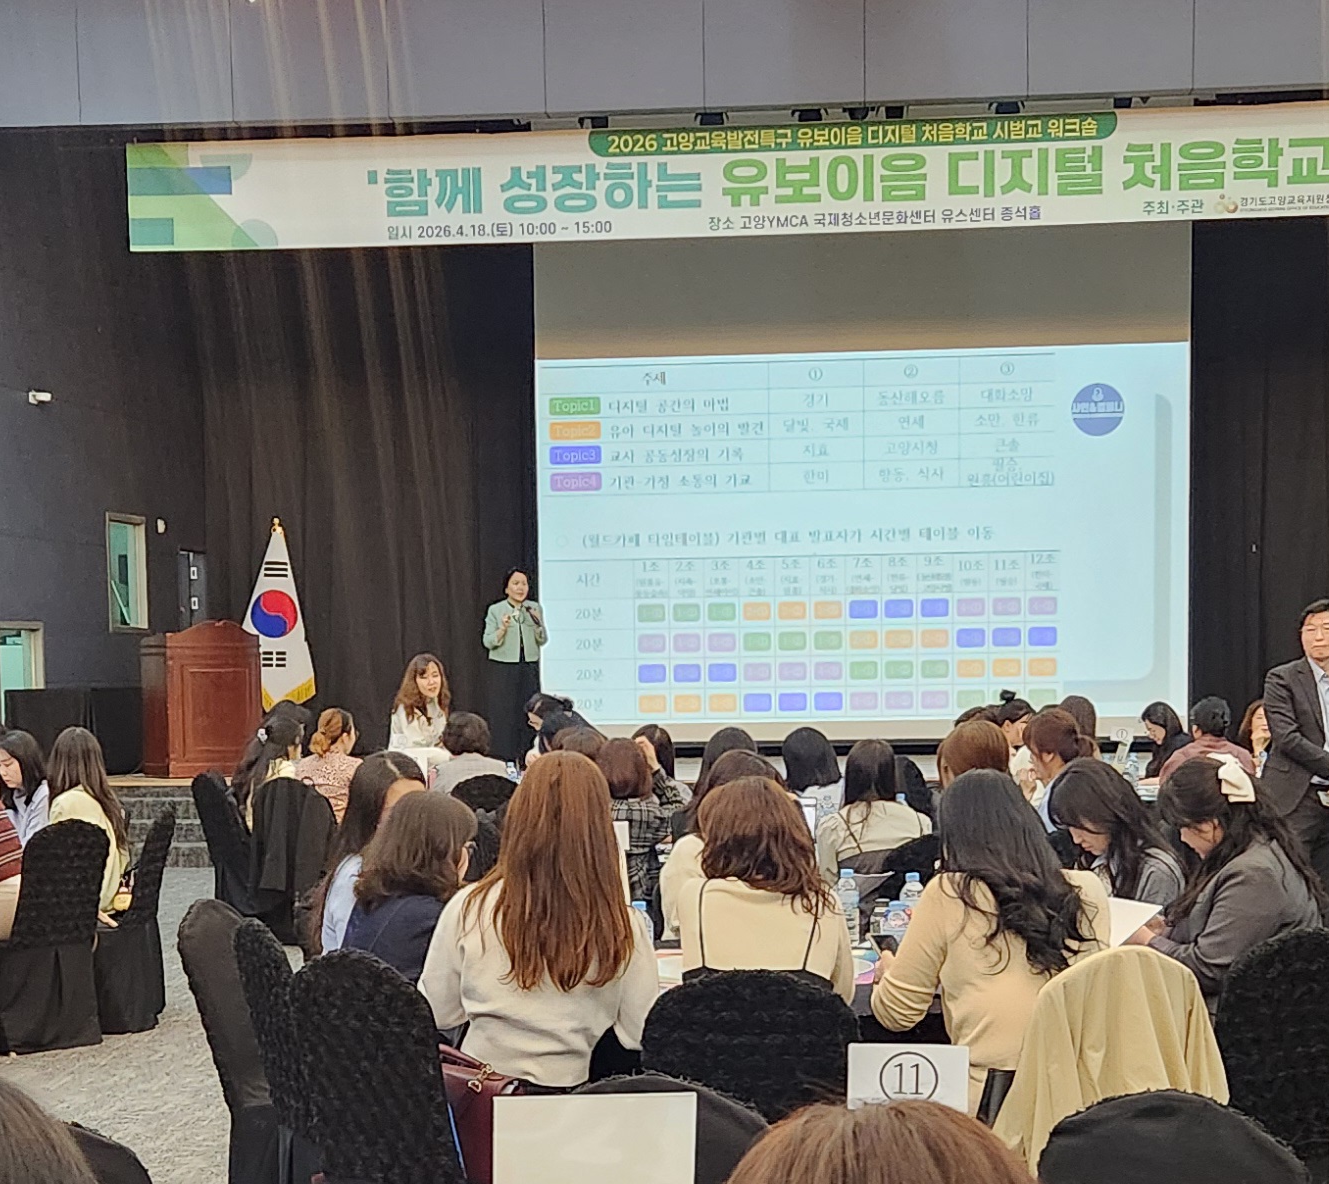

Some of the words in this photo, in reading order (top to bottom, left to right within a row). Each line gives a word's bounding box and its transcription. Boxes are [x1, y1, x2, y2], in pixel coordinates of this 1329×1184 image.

[607, 134, 657, 153] 2026
[662, 128, 792, 151] 고양교육발전특구
[797, 125, 862, 148] 유보이음
[867, 124, 916, 144] 디지털
[921, 122, 988, 142] 처음학교
[993, 119, 1043, 139] 시범교
[1047, 117, 1098, 137] 워크숍
[500, 161, 702, 215] 성장하는
[722, 152, 927, 207] 유보이음
[947, 145, 1103, 198] 디지털
[708, 216, 734, 231] 장소
[740, 214, 809, 230] 고양YMCA
[813, 208, 935, 227] 국제청소년문화센터
[941, 207, 996, 224] 유스센터
[387, 225, 412, 240] 일시
[417, 221, 514, 239] 2026.4.18.(토)
[519, 222, 556, 236] 10:00
[574, 220, 612, 234] 15:00
[553, 400, 595, 414] Topic1
[607, 398, 647, 414] 디지털
[703, 396, 729, 412] 마법
[643, 422, 682, 438] 디지털
[554, 449, 596, 463] Topic3
[553, 475, 596, 489] Topic4
[711, 559, 731, 571] 3조
[746, 559, 767, 570] 4조
[781, 558, 801, 570] 5조
[817, 557, 838, 569] 6조
[853, 556, 873, 568] 7조
[888, 556, 908, 567] 8조
[924, 555, 944, 567] 9조
[958, 559, 984, 571] 10조
[994, 559, 1021, 571] 11조
[1030, 553, 1057, 565] 12조
[641, 561, 660, 573] 1조
[675, 560, 695, 572] 2조
[575, 572, 600, 585] 시간
[575, 607, 604, 620] 20분
[575, 638, 604, 651] 20분
[575, 668, 604, 681] 20분
